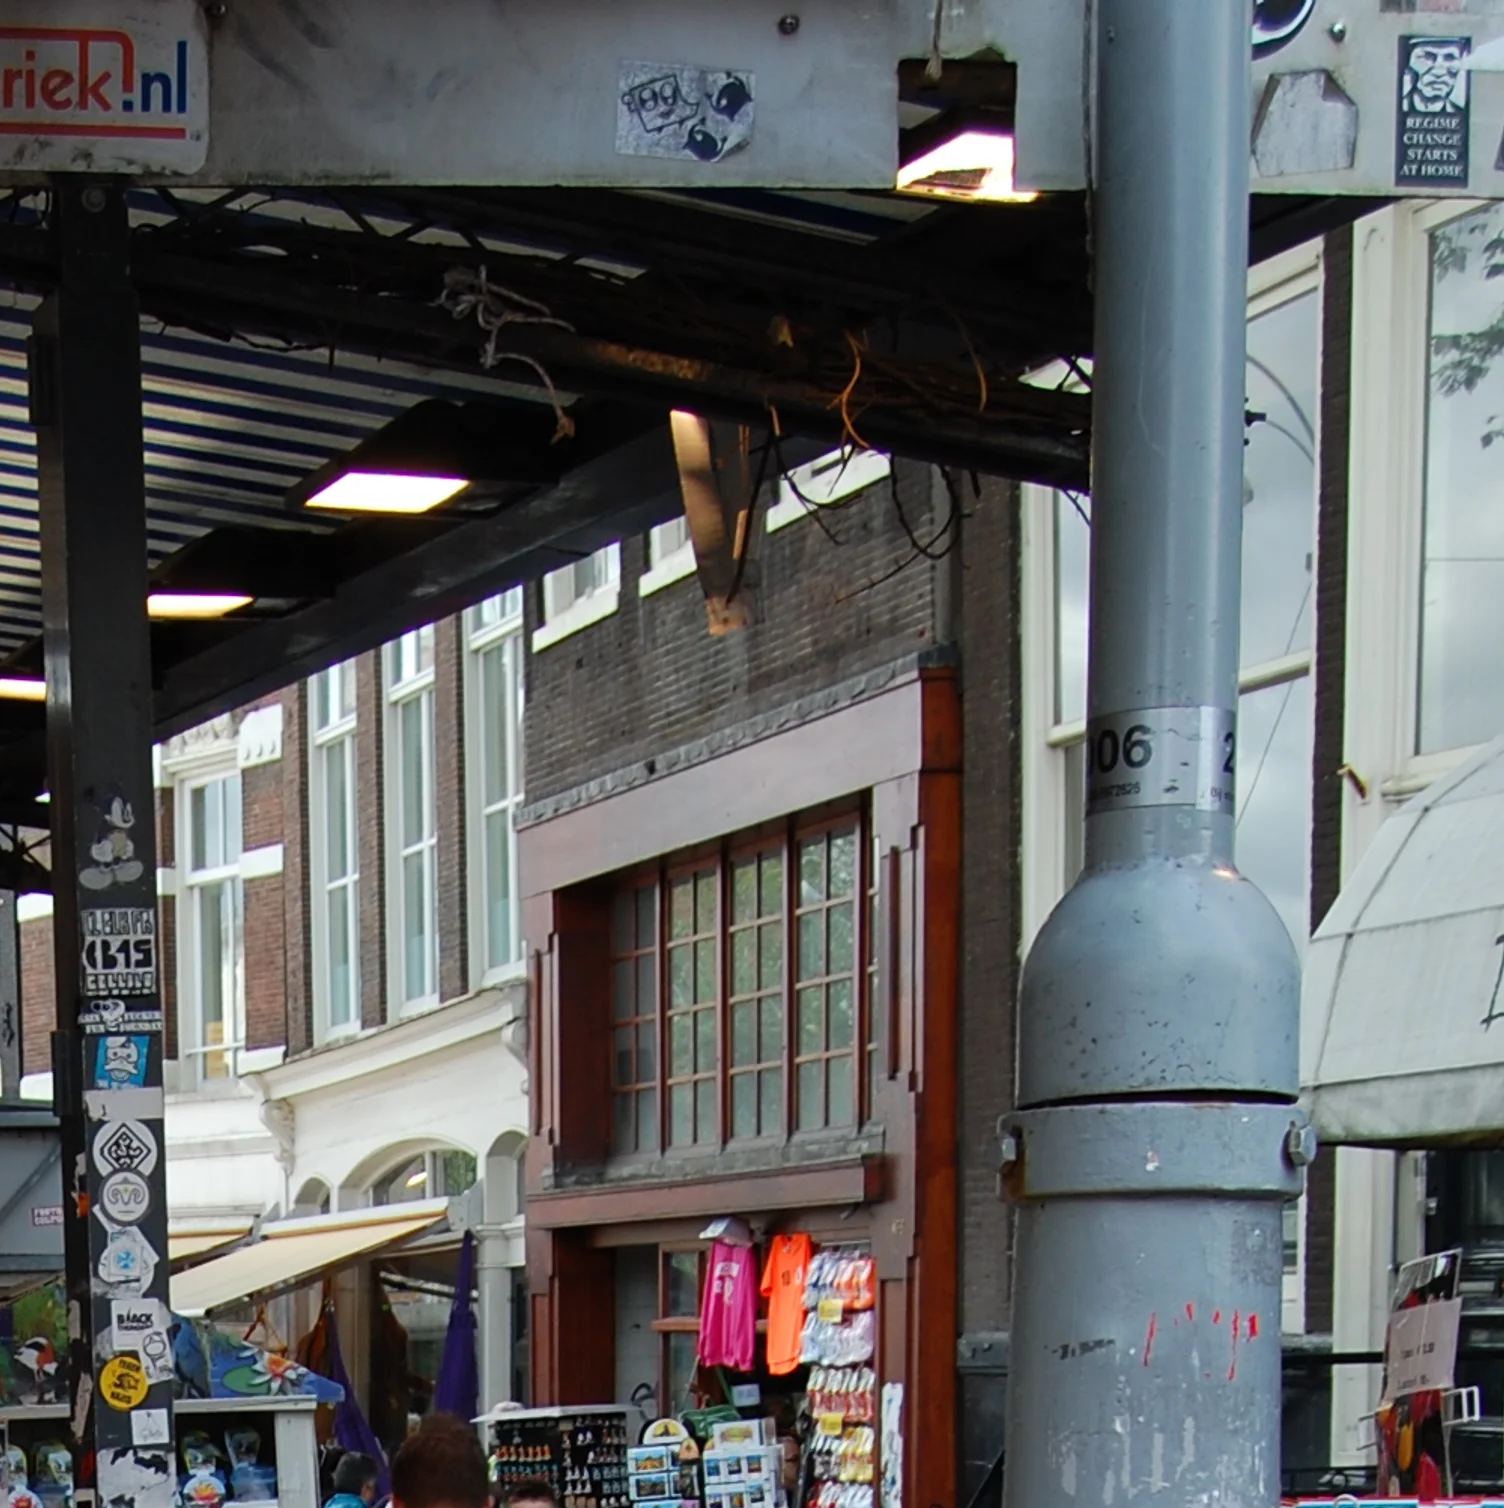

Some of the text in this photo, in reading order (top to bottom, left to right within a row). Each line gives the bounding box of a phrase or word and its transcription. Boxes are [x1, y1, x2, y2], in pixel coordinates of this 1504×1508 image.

[1405, 117, 1461, 130] REGIME
[1402, 132, 1462, 146] CHANGE
[1406, 148, 1459, 162] STARTS
[1400, 163, 1465, 178] AT HOME
